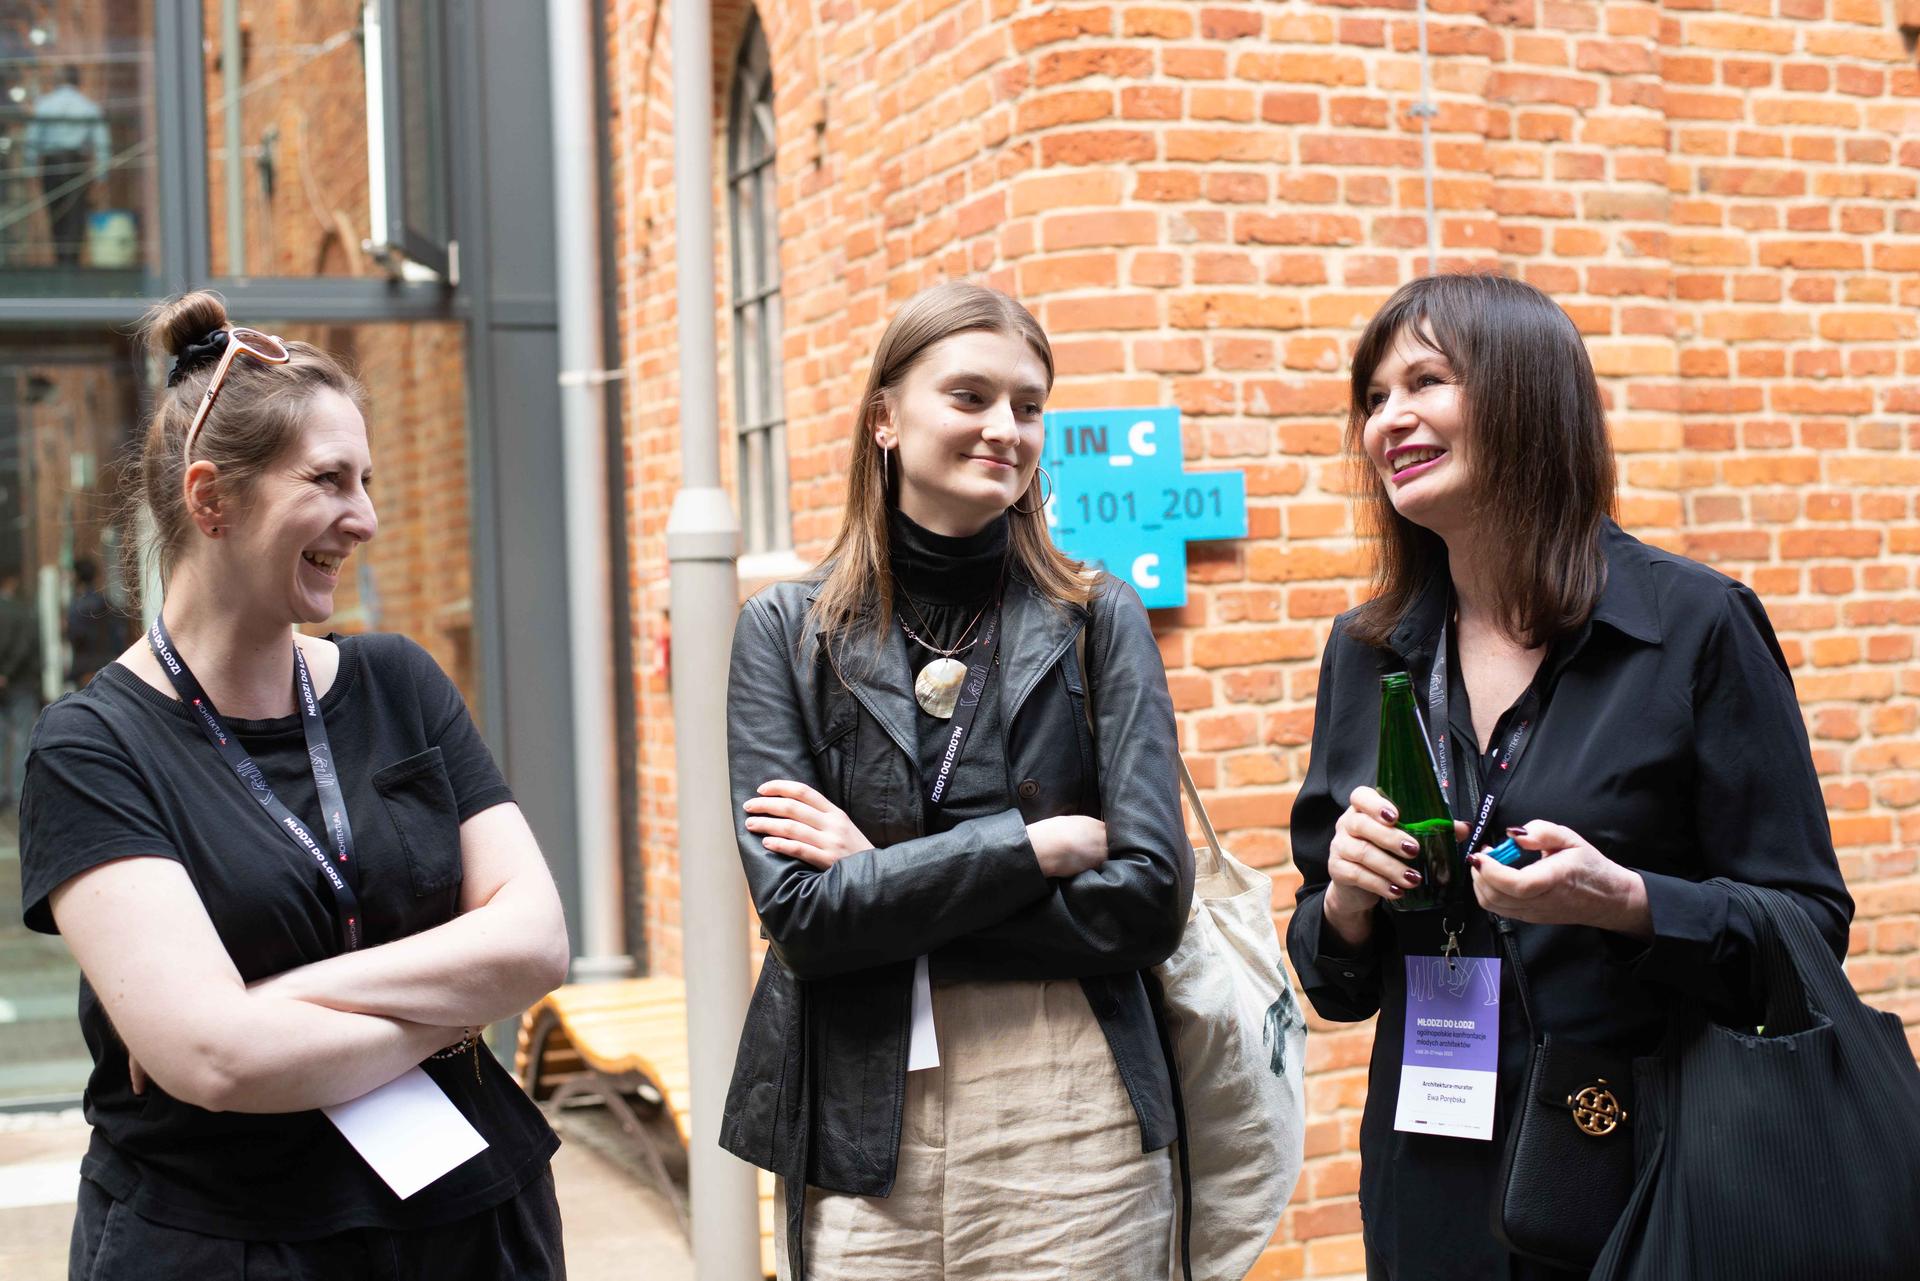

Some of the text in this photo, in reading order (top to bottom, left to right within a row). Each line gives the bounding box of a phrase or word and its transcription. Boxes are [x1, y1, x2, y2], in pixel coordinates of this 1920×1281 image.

[154, 634, 165, 648] DO
[160, 647, 182, 675] ŁODZI
[300, 669, 308, 683] DO
[193, 699, 227, 745] ARCHITEKTURA
[300, 683, 317, 717] MŁODZI
[931, 726, 963, 802] MŁODZI DO ŁODZI
[1438, 734, 1449, 788] ARCHITEKTURA
[1500, 720, 1528, 770] ARCHITEKTURA
[332, 811, 348, 862] ARCHITEKTURA
[1473, 794, 1495, 840] DO ŁODZI
[283, 817, 344, 890] MŁODZI DO ŁODZI
[1417, 1017, 1475, 1030] MŁODZI DO ŁODZI
